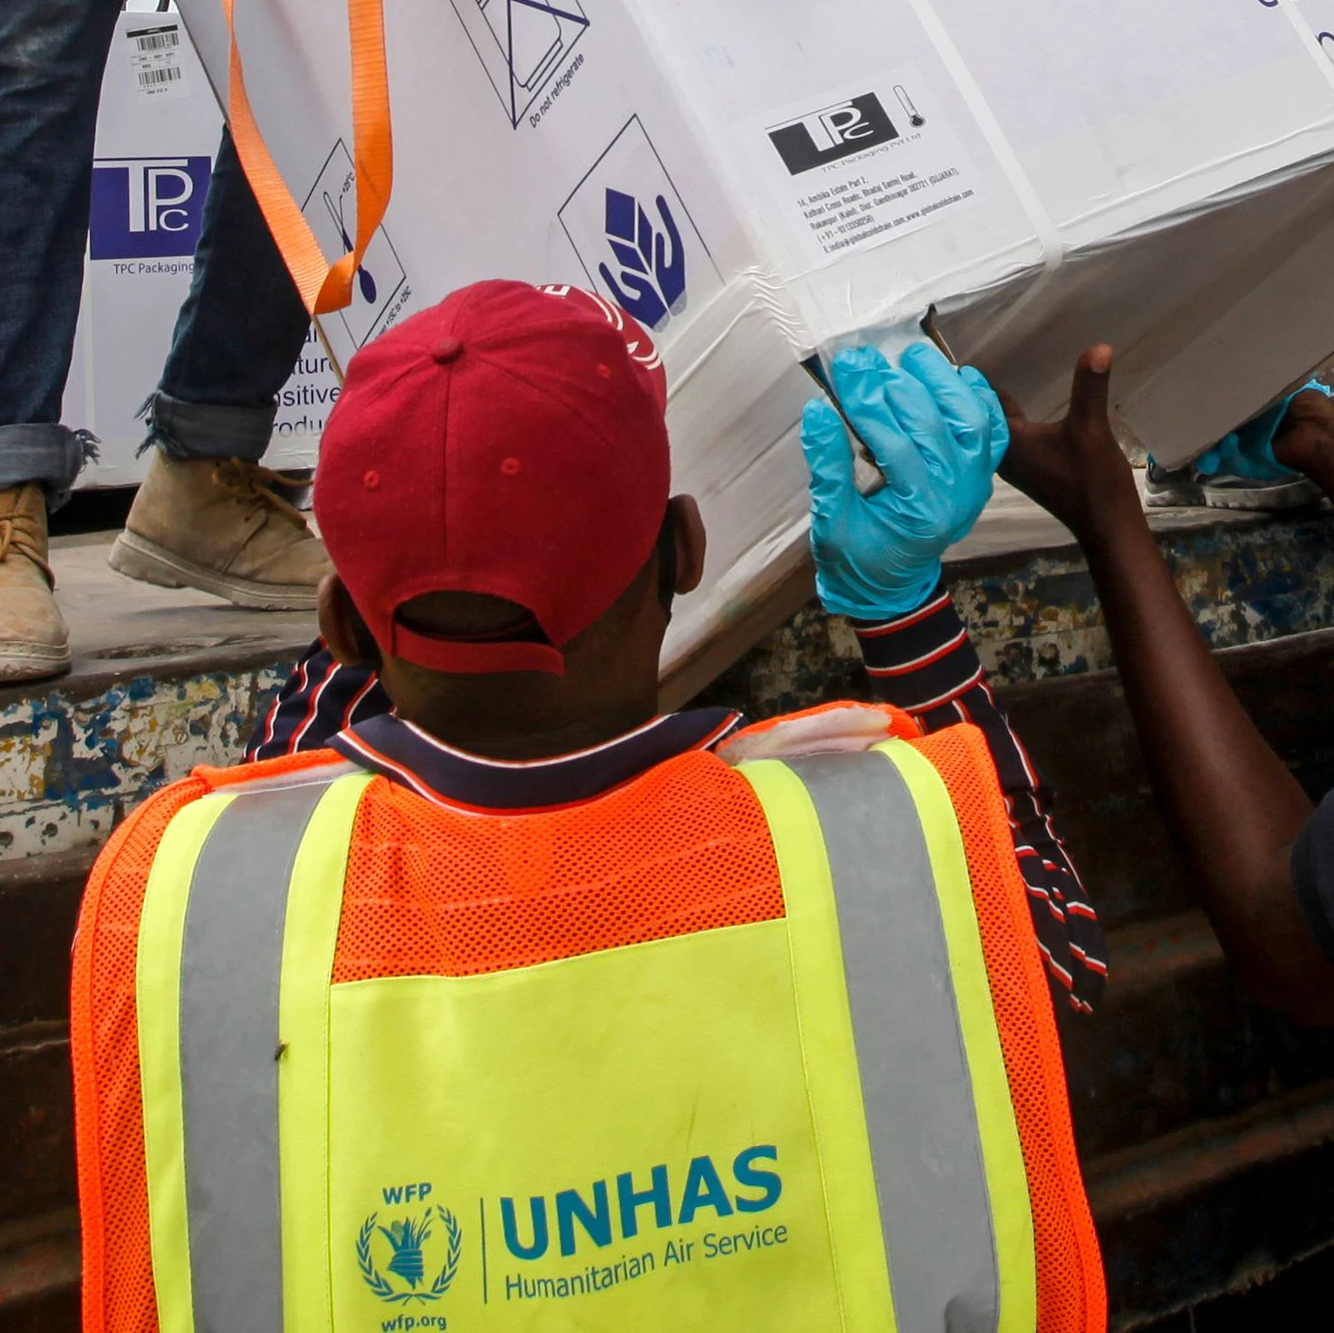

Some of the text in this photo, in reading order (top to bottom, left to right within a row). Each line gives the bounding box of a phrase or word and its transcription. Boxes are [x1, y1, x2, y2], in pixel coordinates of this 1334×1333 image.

[529, 53, 585, 129] Do not refrigerate
[767, 99, 875, 152] TPC
[93, 159, 193, 232] TPC
[114, 263, 136, 275] TPC
[382, 1182, 433, 1206] WFP
[500, 1144, 783, 1261] UNHAS
[506, 1224, 788, 1300] Humanitarian Air Service
[381, 1313, 447, 1333] wfp.org
